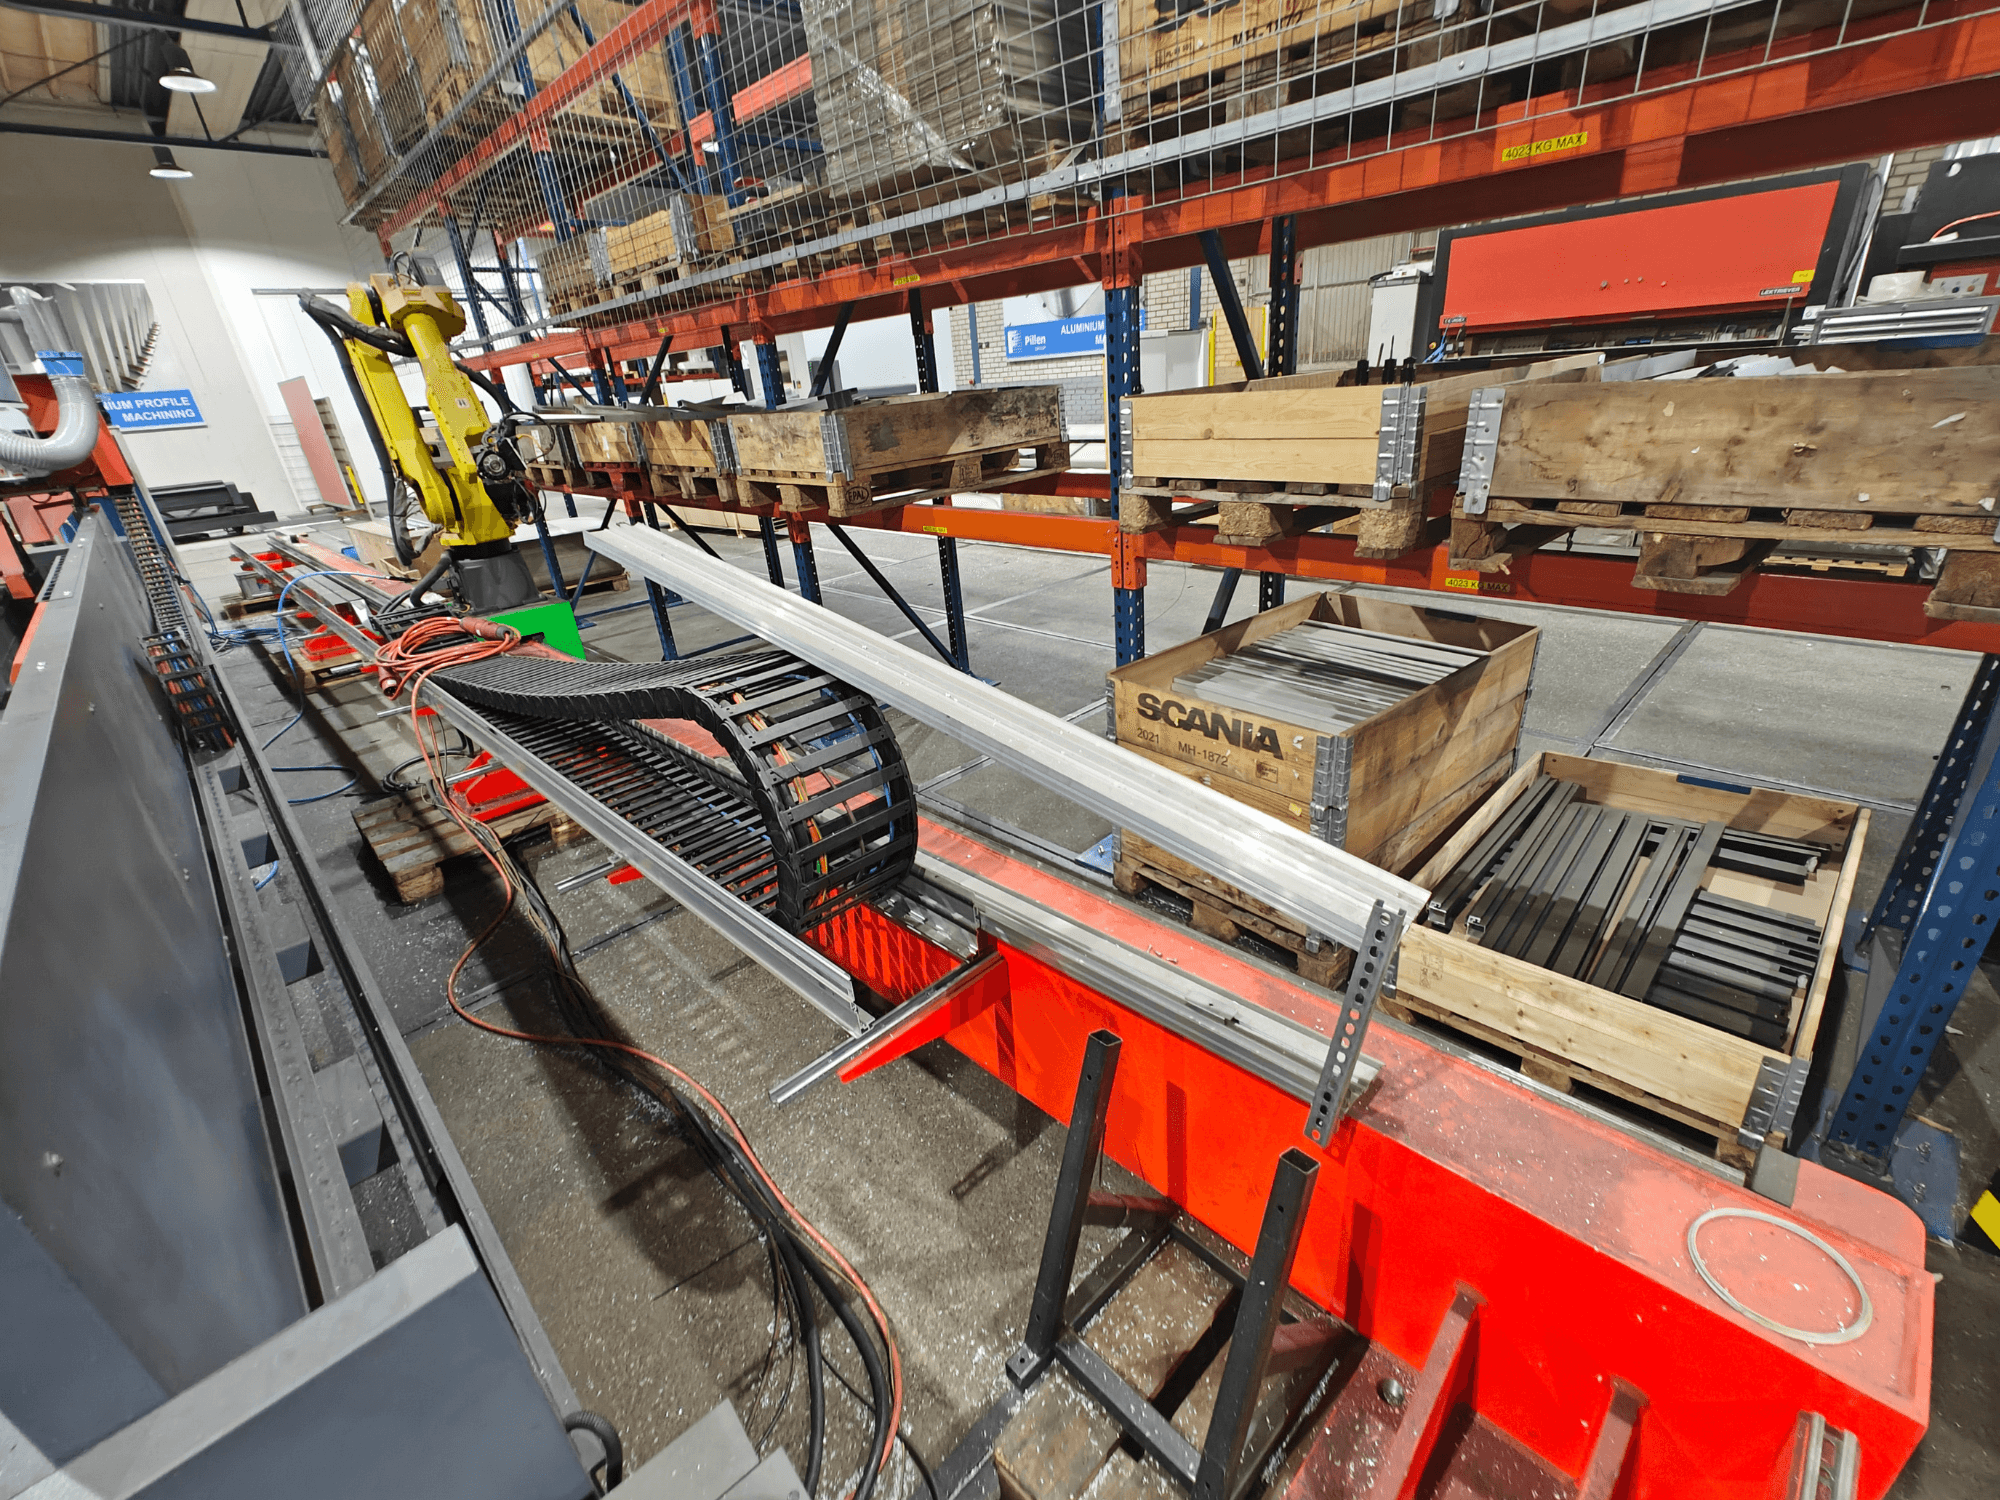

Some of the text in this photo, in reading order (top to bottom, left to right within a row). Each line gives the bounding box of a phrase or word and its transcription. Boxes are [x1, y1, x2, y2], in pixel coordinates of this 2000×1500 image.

[1505, 133, 1583, 159] 4023 KG MAX
[1061, 320, 1105, 335] ALUMINIUM
[1025, 334, 1047, 346] Pillen
[135, 396, 191, 408] PROFILE
[122, 409, 196, 422] MACHINING
[1447, 579, 1508, 592] 4023 KG MAX
[1137, 693, 1284, 761] SCANIA
[1137, 728, 1159, 744] 2021
[1178, 741, 1229, 767] MH-1872
